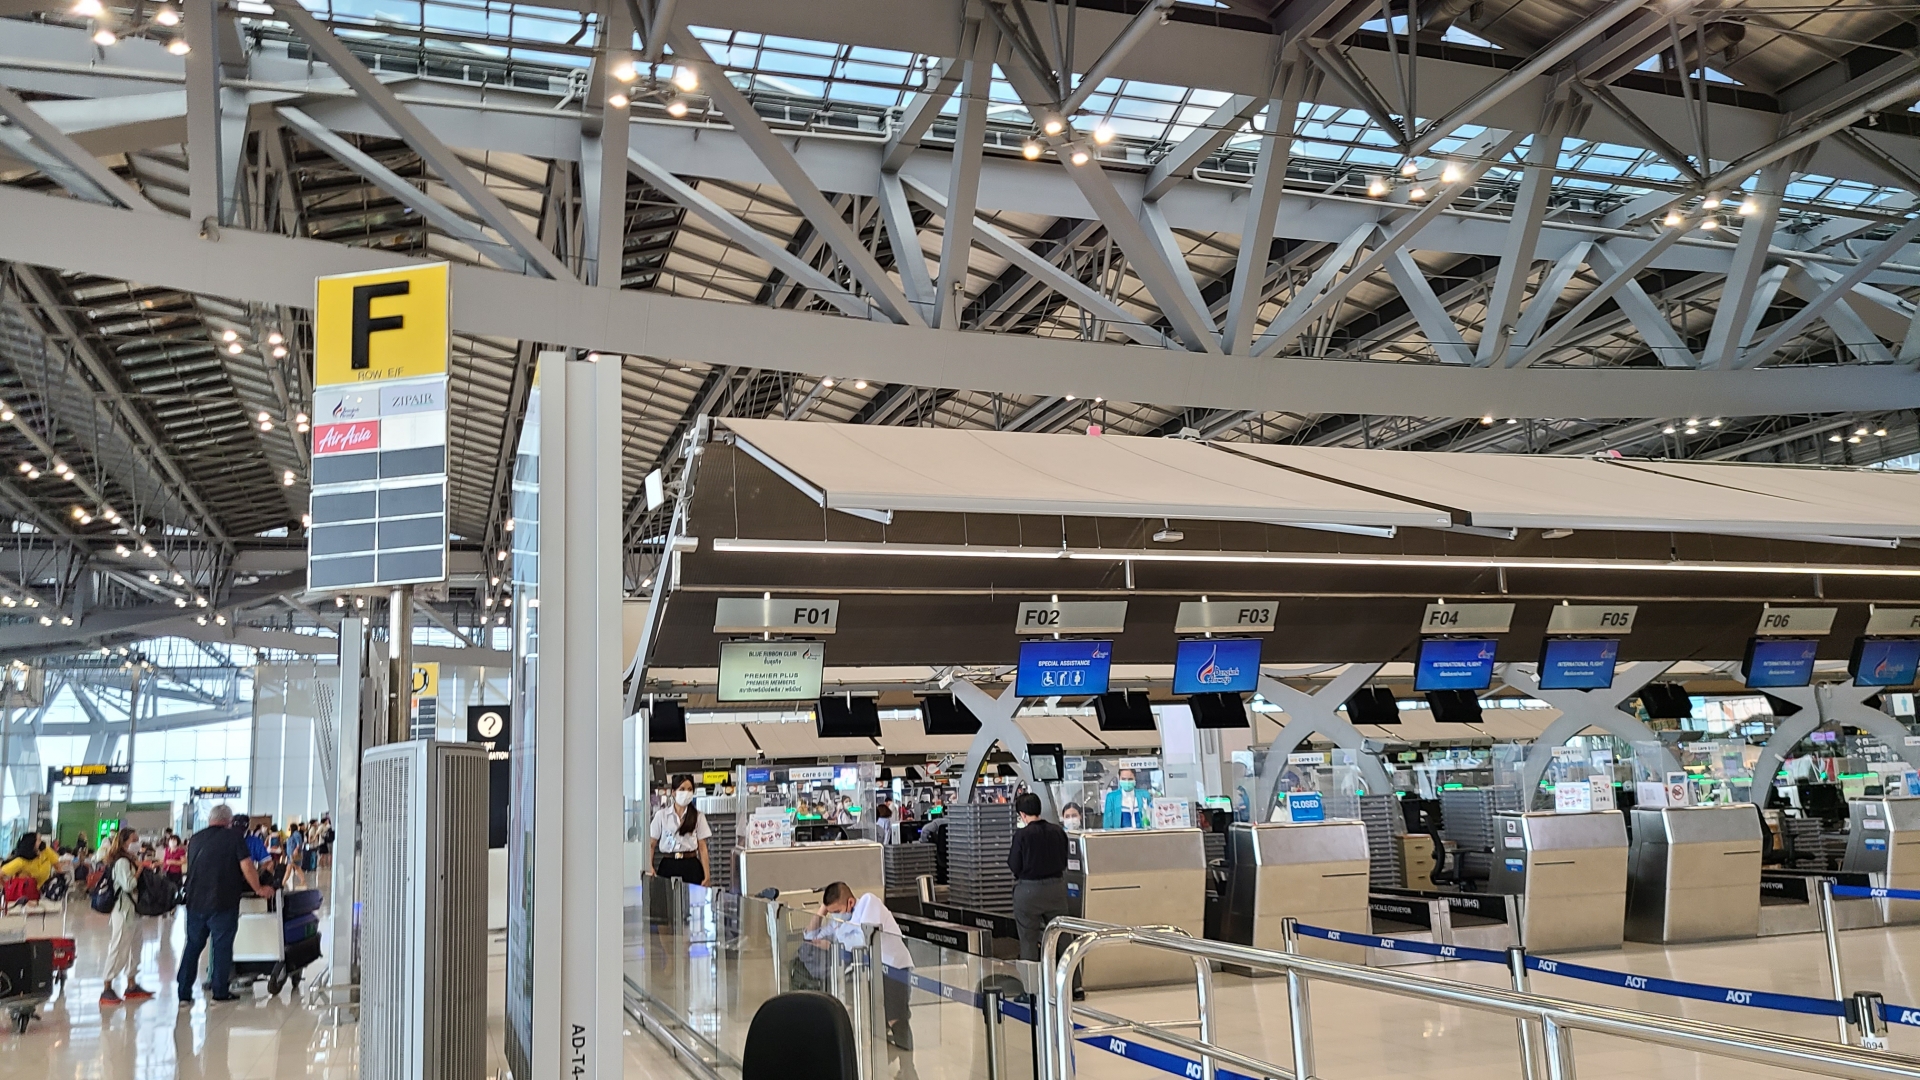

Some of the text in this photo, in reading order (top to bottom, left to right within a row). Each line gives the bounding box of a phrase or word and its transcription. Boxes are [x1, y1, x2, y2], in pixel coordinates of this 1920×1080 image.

[350, 280, 410, 370] F
[357, 366, 404, 381] ROW E/F
[392, 393, 434, 407] ZIPAIR
[793, 607, 830, 625] F01
[1023, 609, 1061, 626] F02
[1237, 608, 1270, 625] F03
[1429, 610, 1459, 626] F04
[1600, 611, 1629, 627] F05
[1764, 614, 1791, 628] F06
[749, 650, 763, 658] BLUE
[1060, 659, 1091, 667] ASSISTANCE
[1292, 799, 1319, 809] CLOSED
[1761, 881, 1784, 890] NVEYOR
[1870, 888, 1888, 897] AOT
[1462, 898, 1480, 909] (BHS)
[1327, 930, 1341, 940] AOT
[1380, 938, 1395, 949] AOT
[1440, 946, 1456, 957] AOT
[1537, 959, 1558, 973] AOT
[1624, 975, 1648, 989] AOT
[943, 985, 953, 998] AOT
[1725, 989, 1752, 1004] AOT
[1900, 1010, 1920, 1026] AO
[1109, 1037, 1127, 1055] AOT
[1185, 1061, 1202, 1080] AO
